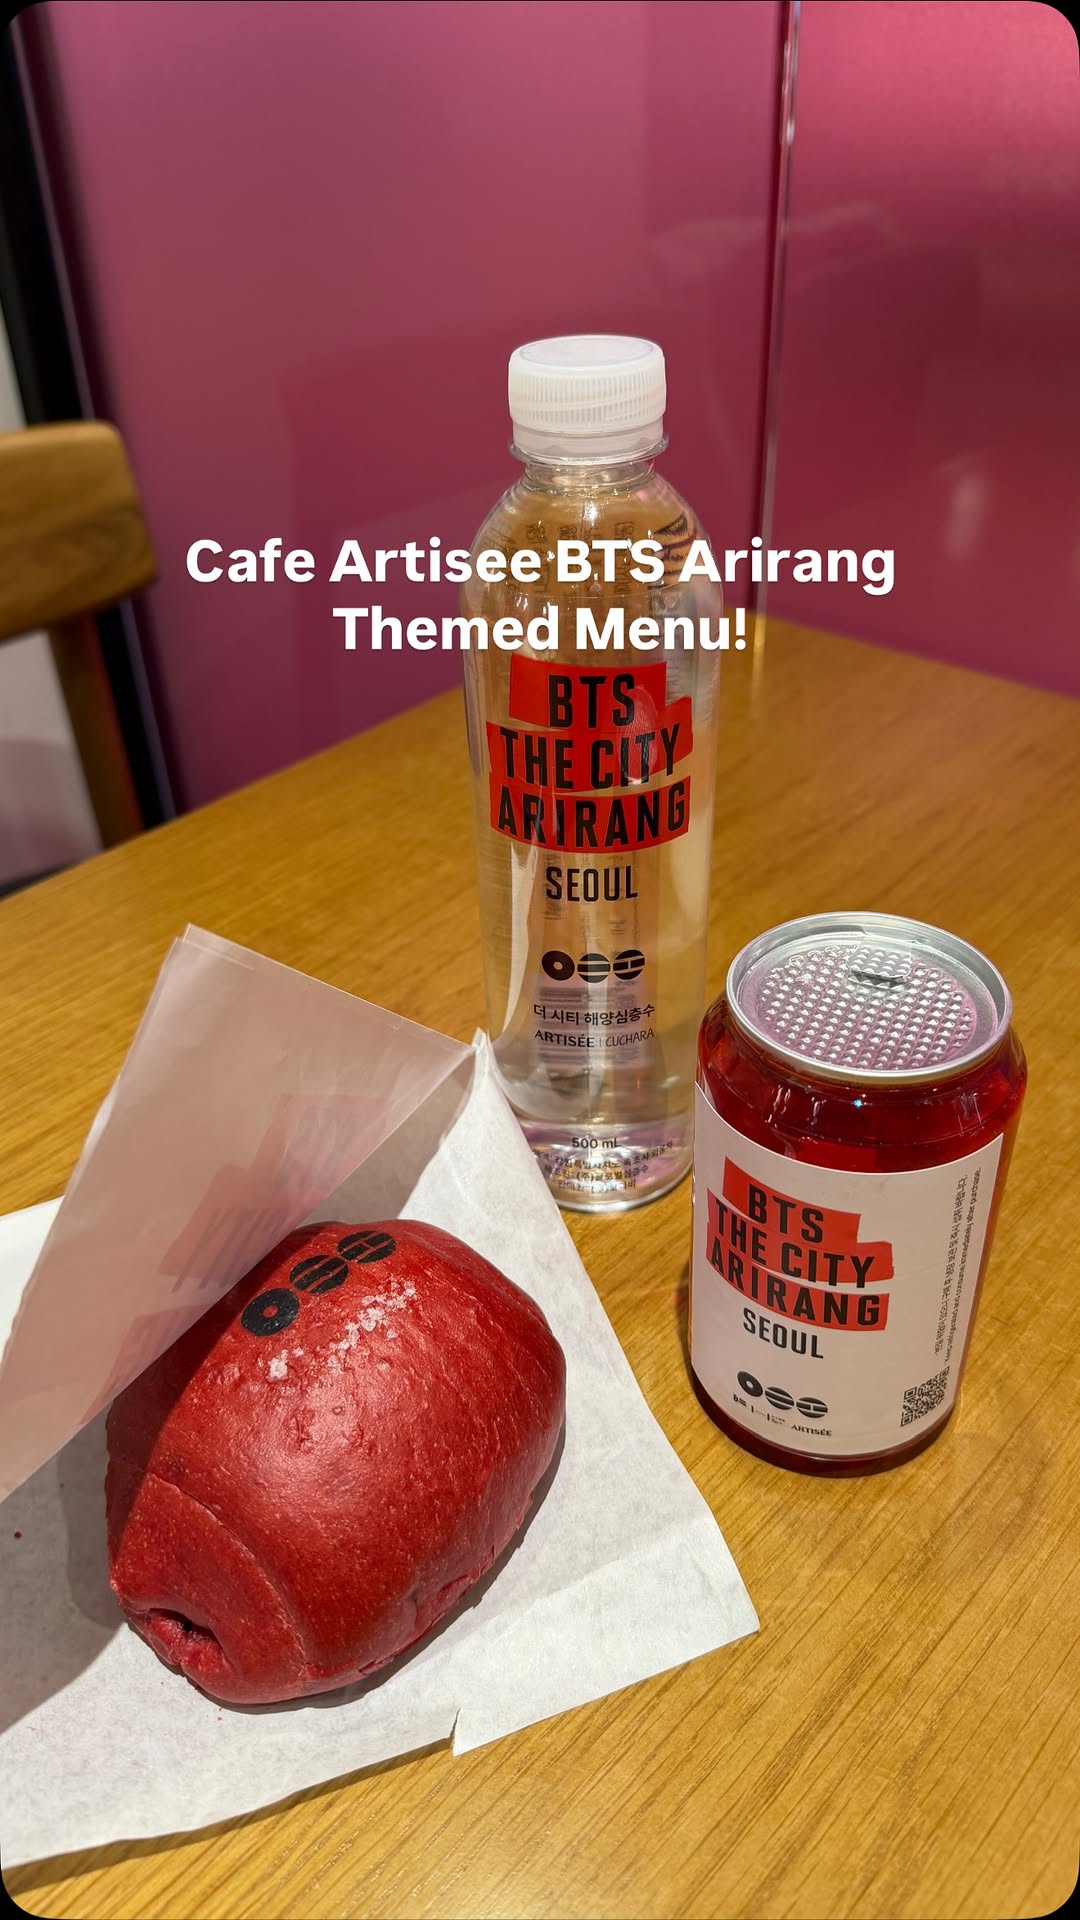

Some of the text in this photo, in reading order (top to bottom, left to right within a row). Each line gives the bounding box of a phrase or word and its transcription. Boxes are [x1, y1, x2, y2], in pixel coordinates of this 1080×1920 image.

[549, 673, 635, 729] BTS
[500, 722, 680, 789] THE CITY
[498, 781, 685, 848] ARIRANG
[546, 865, 638, 902] SEOUL
[533, 1003, 655, 1026] 더 시티 해양심층수
[535, 1028, 655, 1048] ARTISÉE CUCHARA
[572, 1137, 621, 1149] 500 mL
[749, 1183, 824, 1244] BTS
[715, 1198, 875, 1289] THE CITY
[711, 1236, 880, 1326] ARIRANG
[743, 1307, 824, 1359] SEOUL
[791, 1423, 833, 1437] ARTISÉE
